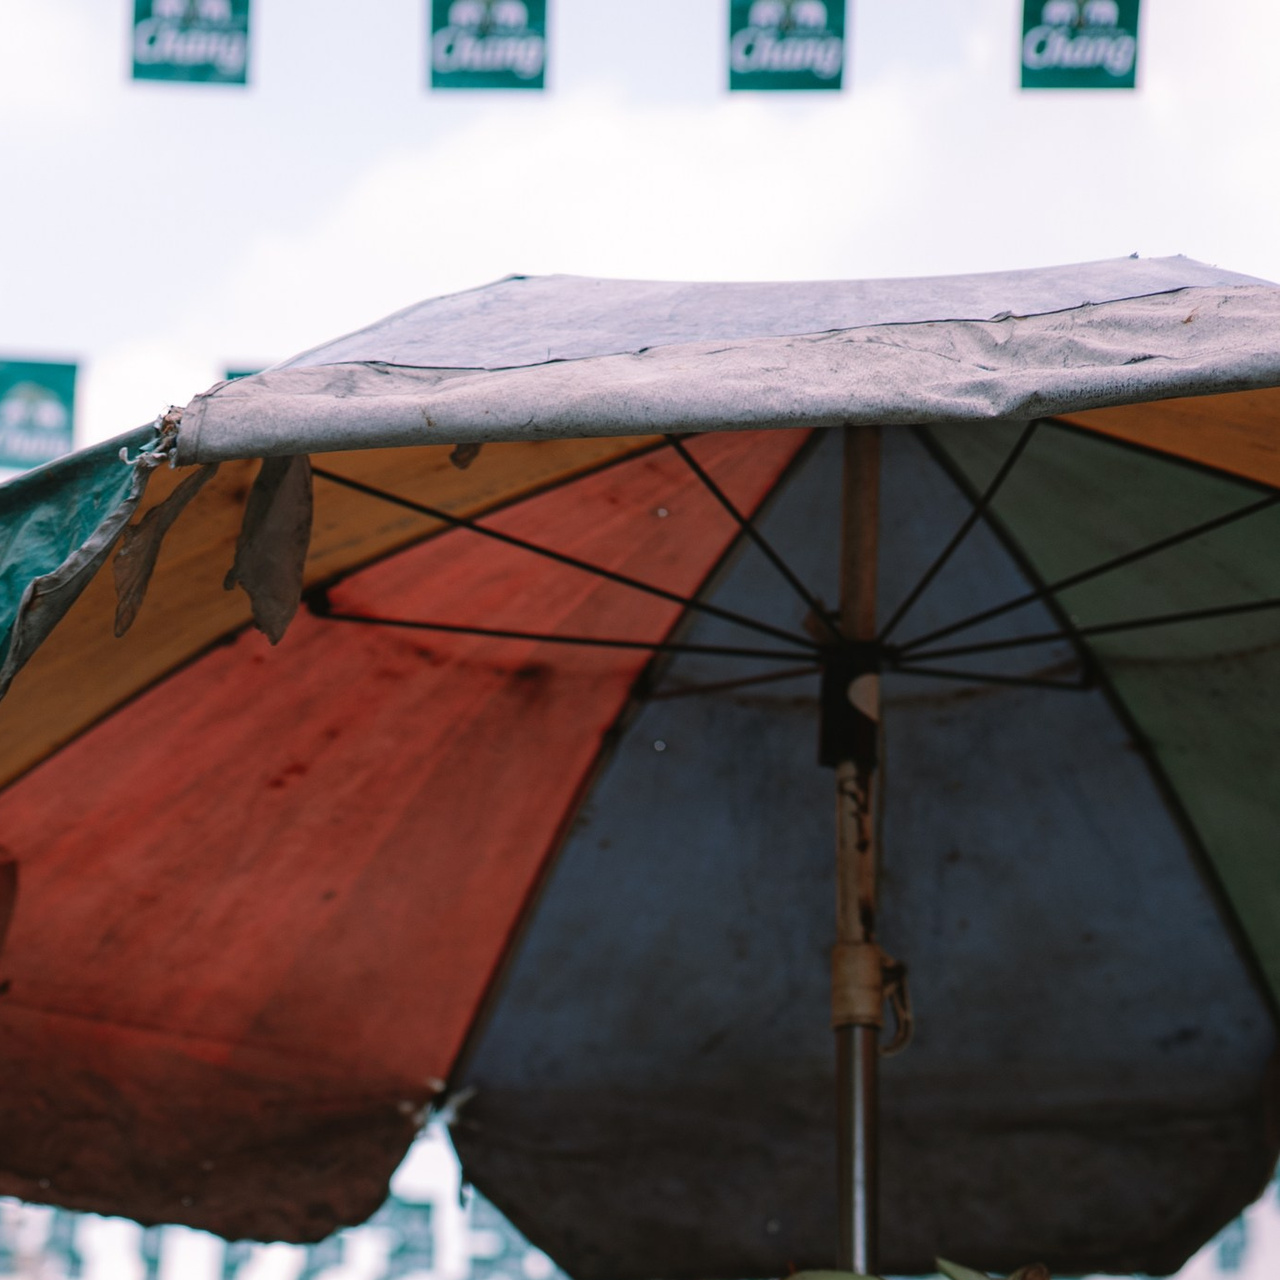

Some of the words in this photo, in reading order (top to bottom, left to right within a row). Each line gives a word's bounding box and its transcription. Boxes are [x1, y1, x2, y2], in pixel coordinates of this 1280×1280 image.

[134, 17, 247, 75] Chang
[432, 26, 543, 79] Chang
[731, 26, 841, 79] Chang
[1023, 24, 1136, 76] Chang
